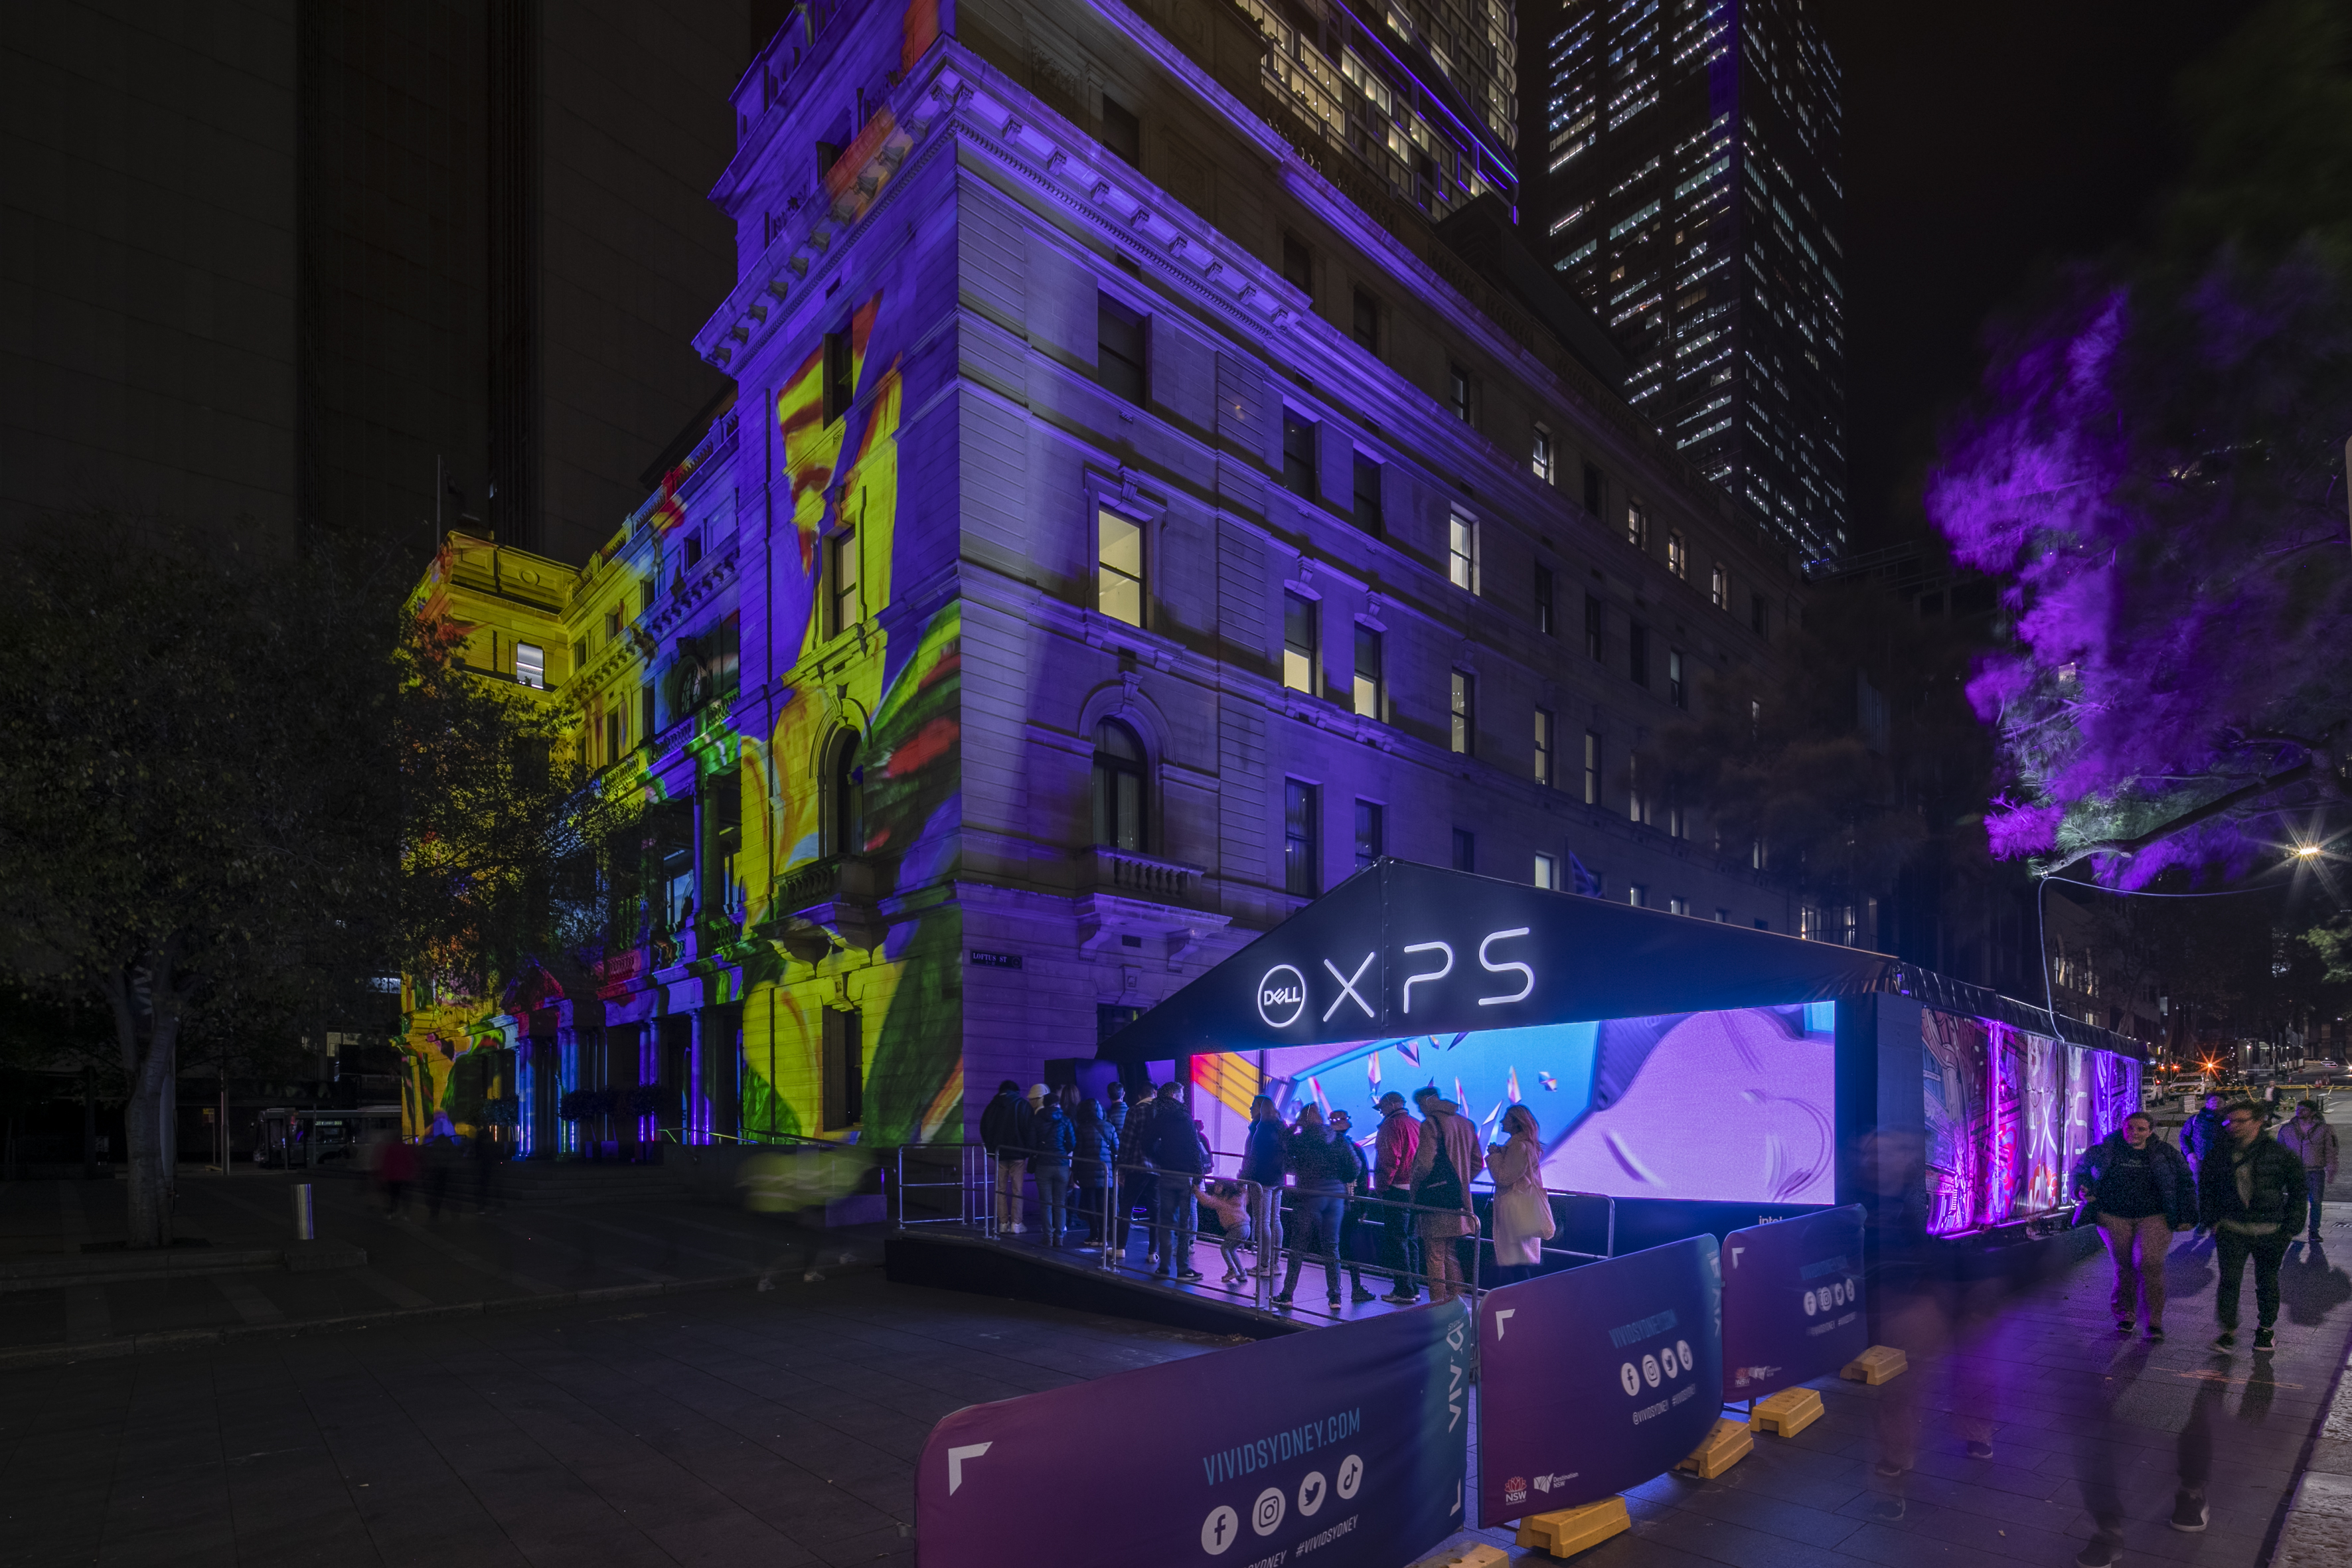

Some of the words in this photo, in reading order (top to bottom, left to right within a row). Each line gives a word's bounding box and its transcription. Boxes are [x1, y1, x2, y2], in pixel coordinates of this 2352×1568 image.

[973, 952, 996, 961] LOFTUS
[1323, 926, 1535, 1023] XPS
[1264, 986, 1300, 1006] DELL
[1202, 1407, 1361, 1486] VIVIDSYDNEY.COM
[1553, 1472, 1579, 1483] Destination
[1506, 1490, 1527, 1503] NSW
[1295, 1514, 1359, 1558] #VIVIDSYDNEY
